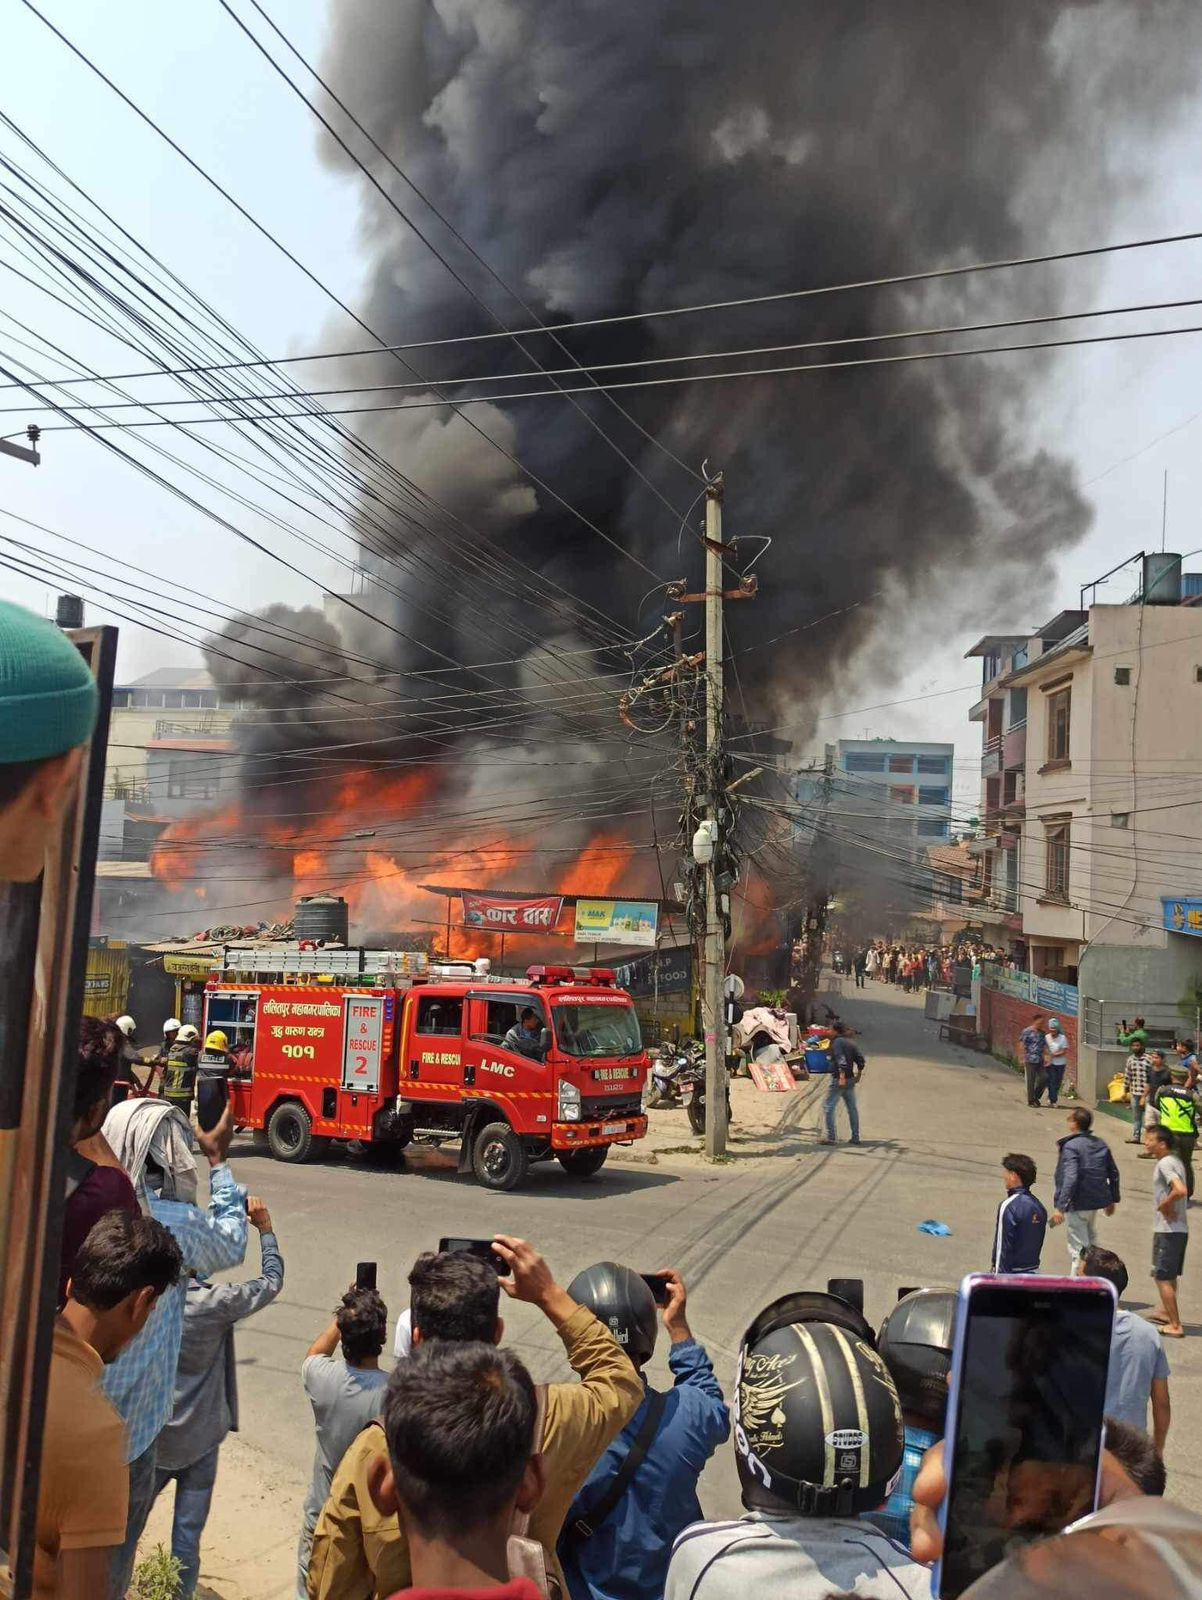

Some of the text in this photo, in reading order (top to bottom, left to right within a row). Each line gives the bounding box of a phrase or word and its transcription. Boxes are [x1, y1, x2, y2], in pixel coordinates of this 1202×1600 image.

[486, 906, 519, 925] कार
[263, 999, 290, 1018] ललितपुर
[352, 1006, 377, 1019] FIRE
[360, 1022, 368, 1034] &
[281, 1044, 315, 1059] १०१
[350, 1039, 377, 1051] RESCUE
[354, 1056, 368, 1074] 2
[422, 1051, 461, 1066] FIRE & RESCU
[480, 1058, 515, 1078] LMC
[832, 1432, 863, 1446] STUDDS
